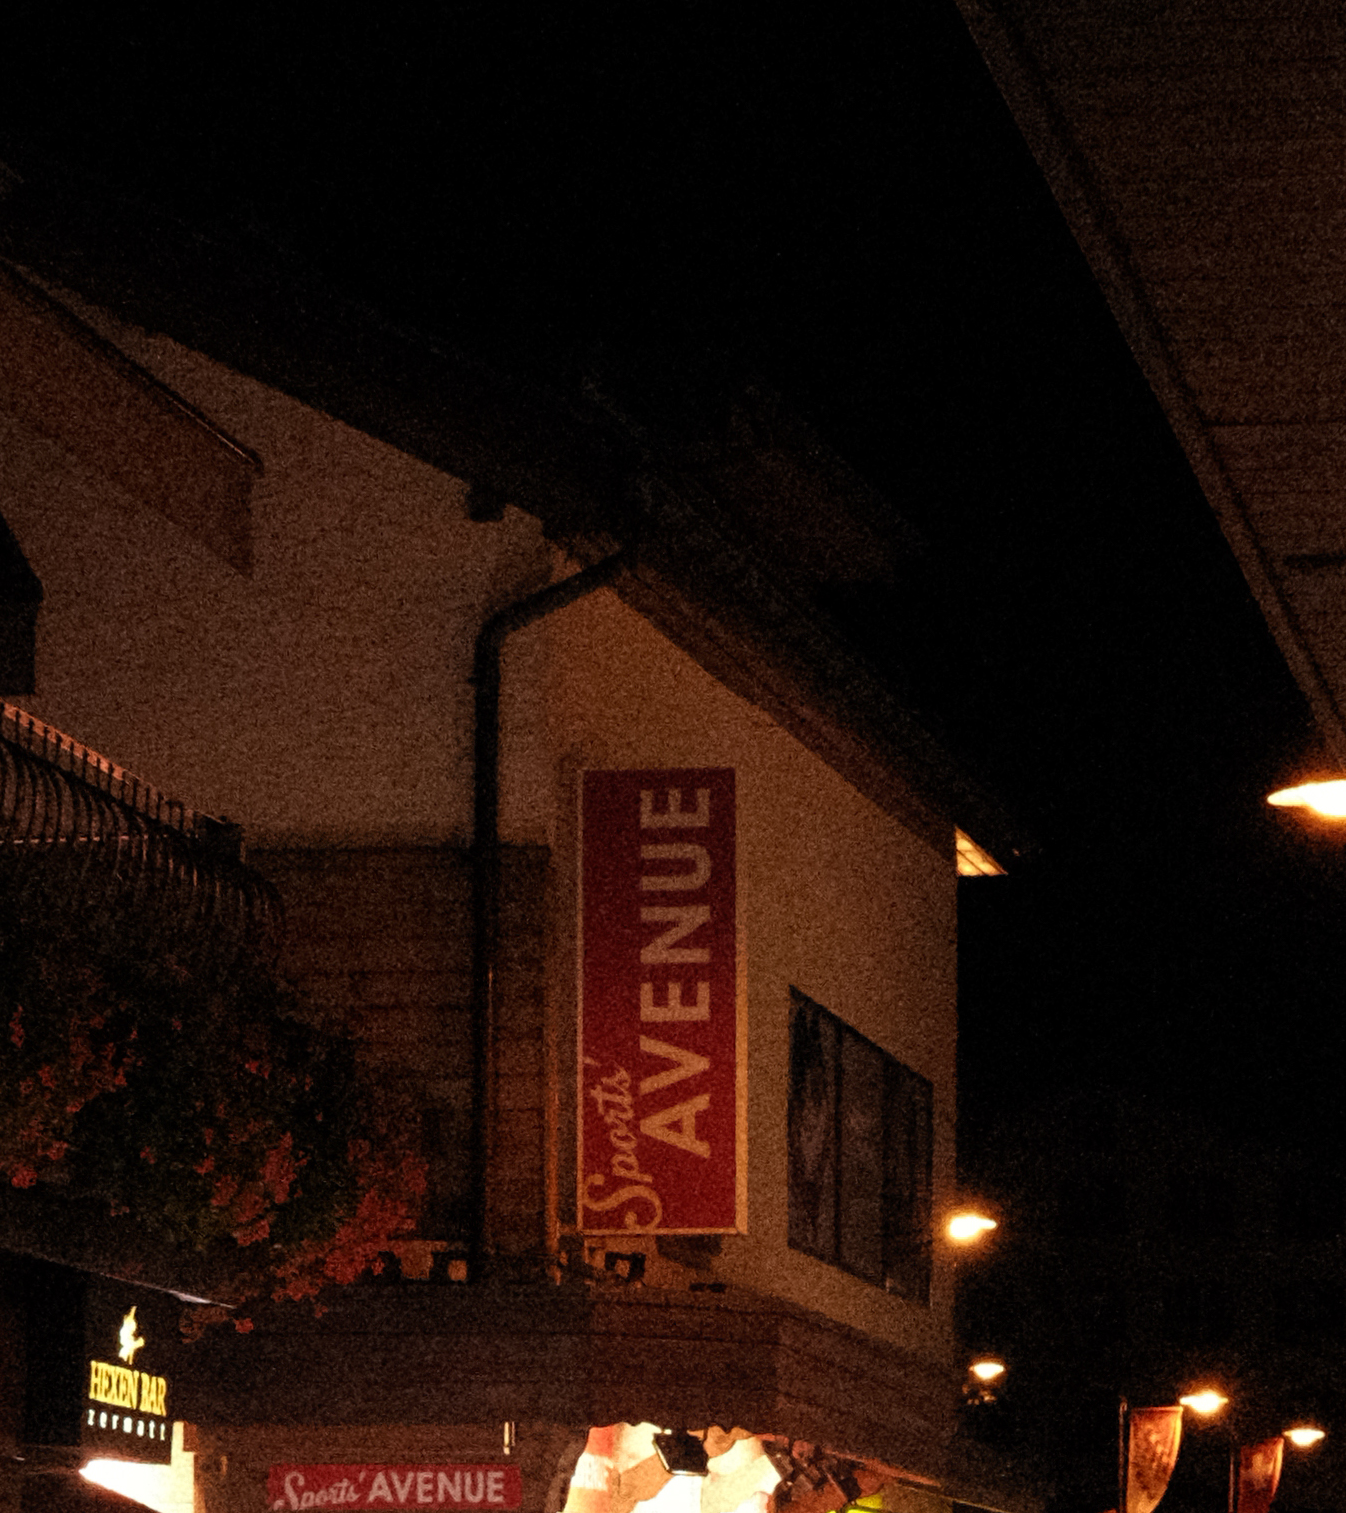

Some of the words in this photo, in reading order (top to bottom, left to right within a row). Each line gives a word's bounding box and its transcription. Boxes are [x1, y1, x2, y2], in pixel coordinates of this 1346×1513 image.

[639, 788, 712, 1160] AVENUE
[88, 1359, 141, 1411] HEXEN
[139, 1371, 168, 1418] BAR
[366, 1470, 506, 1504] AVENUE
